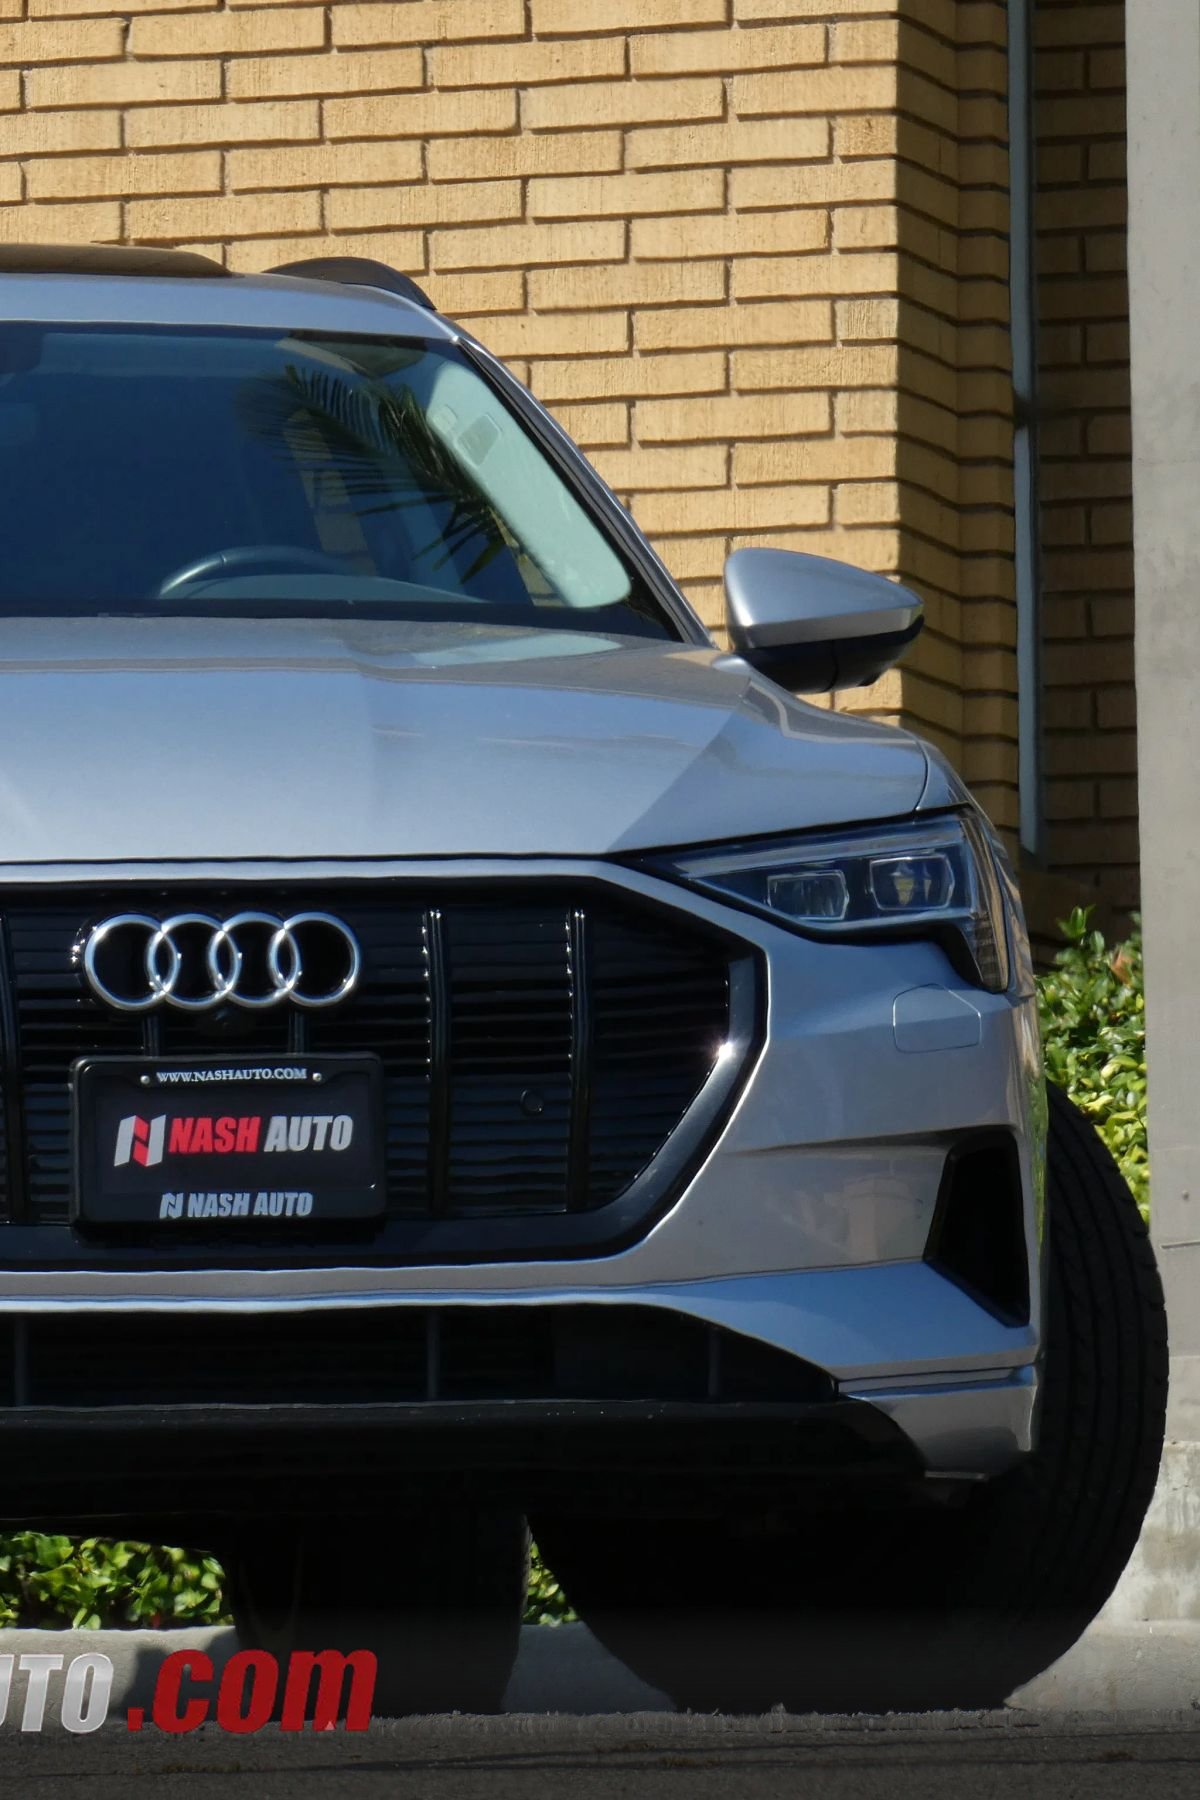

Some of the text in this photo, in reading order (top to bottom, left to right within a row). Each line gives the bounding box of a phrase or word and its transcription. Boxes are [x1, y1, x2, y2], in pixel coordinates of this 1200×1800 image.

[156, 1068, 308, 1083] WWW.NASHAUTO.COM
[168, 1116, 262, 1153] NASH
[263, 1114, 354, 1152] AUTO
[187, 1192, 250, 1218] NASH
[253, 1191, 313, 1217] AUTO
